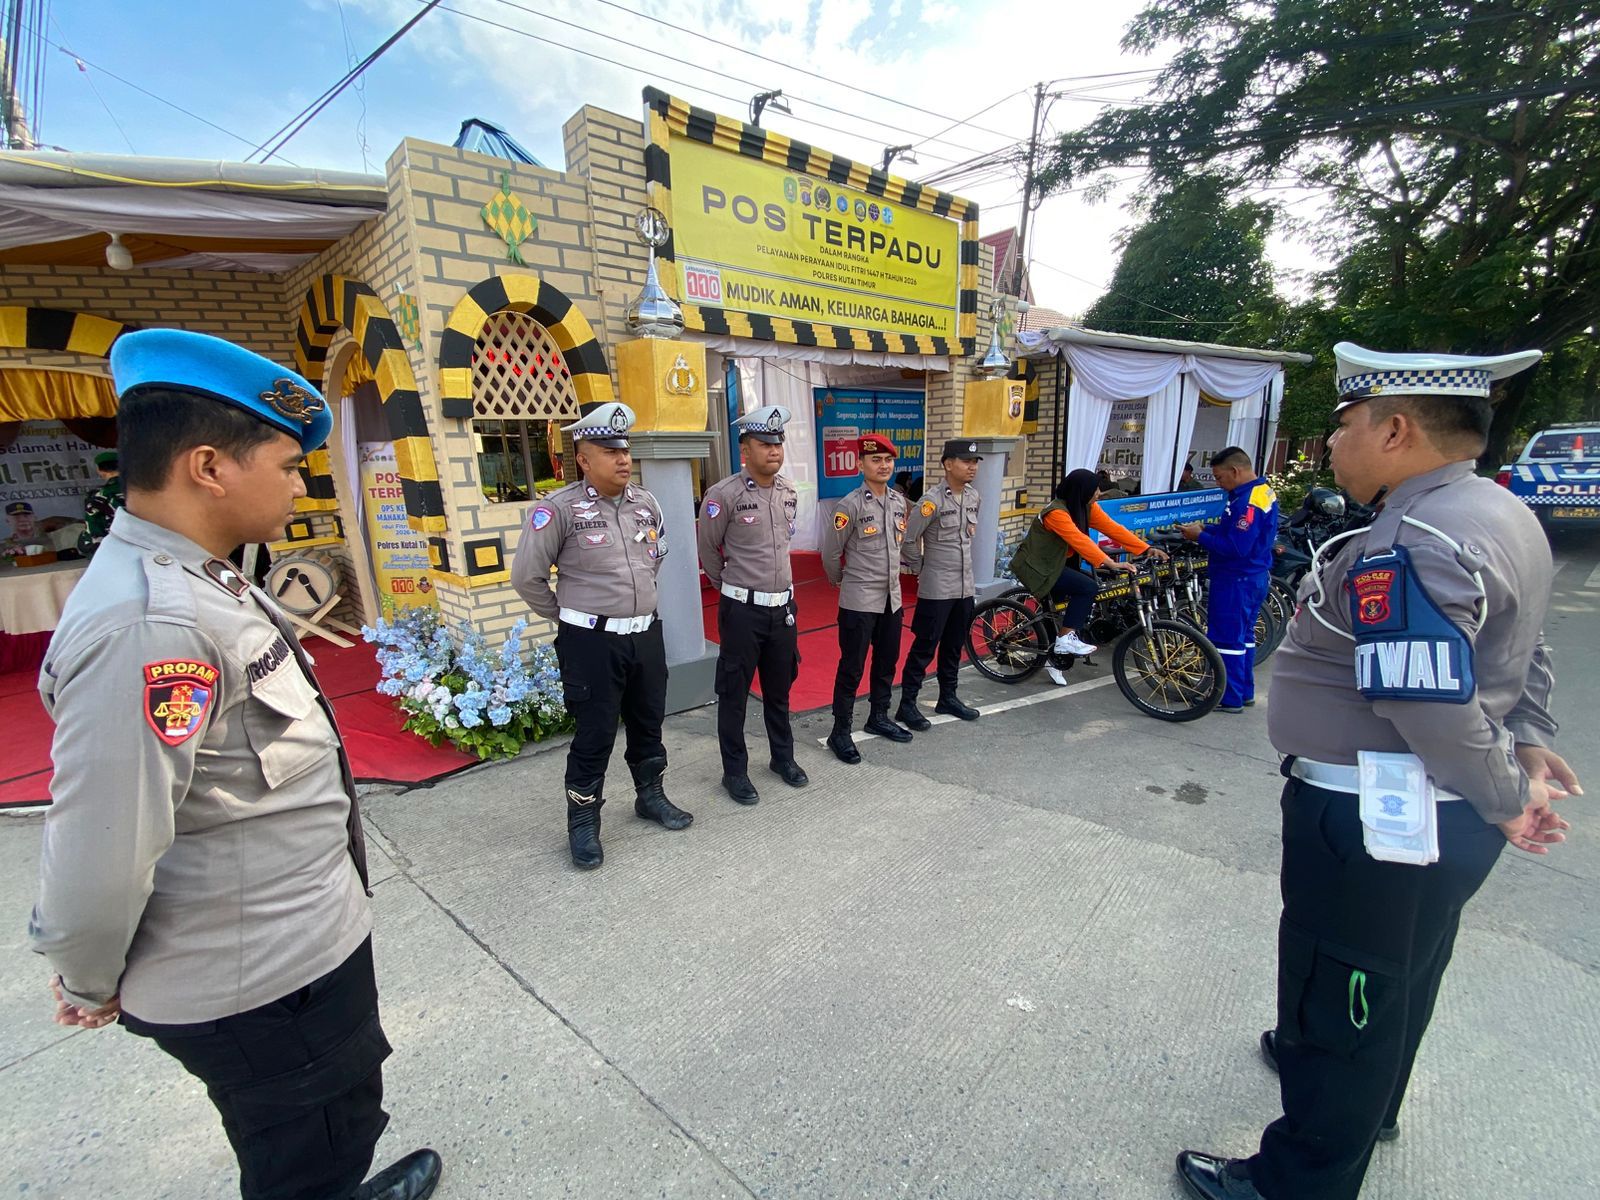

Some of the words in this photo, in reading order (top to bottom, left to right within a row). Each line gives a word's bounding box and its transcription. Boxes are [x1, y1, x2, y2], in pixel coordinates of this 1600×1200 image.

[702, 185, 786, 232] POS
[802, 212, 940, 269] TERPADU
[820, 246, 842, 258] DALAM
[843, 252, 869, 264] RANGKA
[756, 244, 798, 261] PELAYANAN
[800, 254, 835, 269] PERAYAAN
[836, 262, 850, 273] IDUL
[851, 265, 866, 276] FITRI
[866, 268, 880, 278] 1447
[880, 271, 885, 279] H
[885, 272, 903, 283] TAHUN
[903, 276, 917, 286] 2026
[687, 273, 720, 299] 110
[812, 270, 838, 282] POLRES
[838, 275, 857, 285] KUTAI
[857, 278, 876, 289] TIMUR
[726, 281, 776, 306] MUDIK
[779, 291, 824, 316] AMAN,
[827, 299, 888, 324] KELUARGA
[891, 310, 946, 331] BAHAGIA...!
[1106, 435, 1140, 443] Selamat
[0, 443, 62, 455] Selamat
[903, 446, 922, 459] 1447
[828, 451, 856, 471] 110
[22, 458, 90, 483] Fitri
[1536, 484, 1600, 495] POLI
[736, 503, 758, 512] UMAM
[1149, 500, 1166, 509] MUDIK
[1182, 495, 1205, 506] KELUARGA
[574, 520, 608, 531] ELIEZER
[859, 515, 875, 524] YUDI
[377, 541, 400, 549] Polres
[401, 541, 418, 549] Kutai
[391, 580, 414, 592] 110
[151, 662, 215, 683] PROPAM
